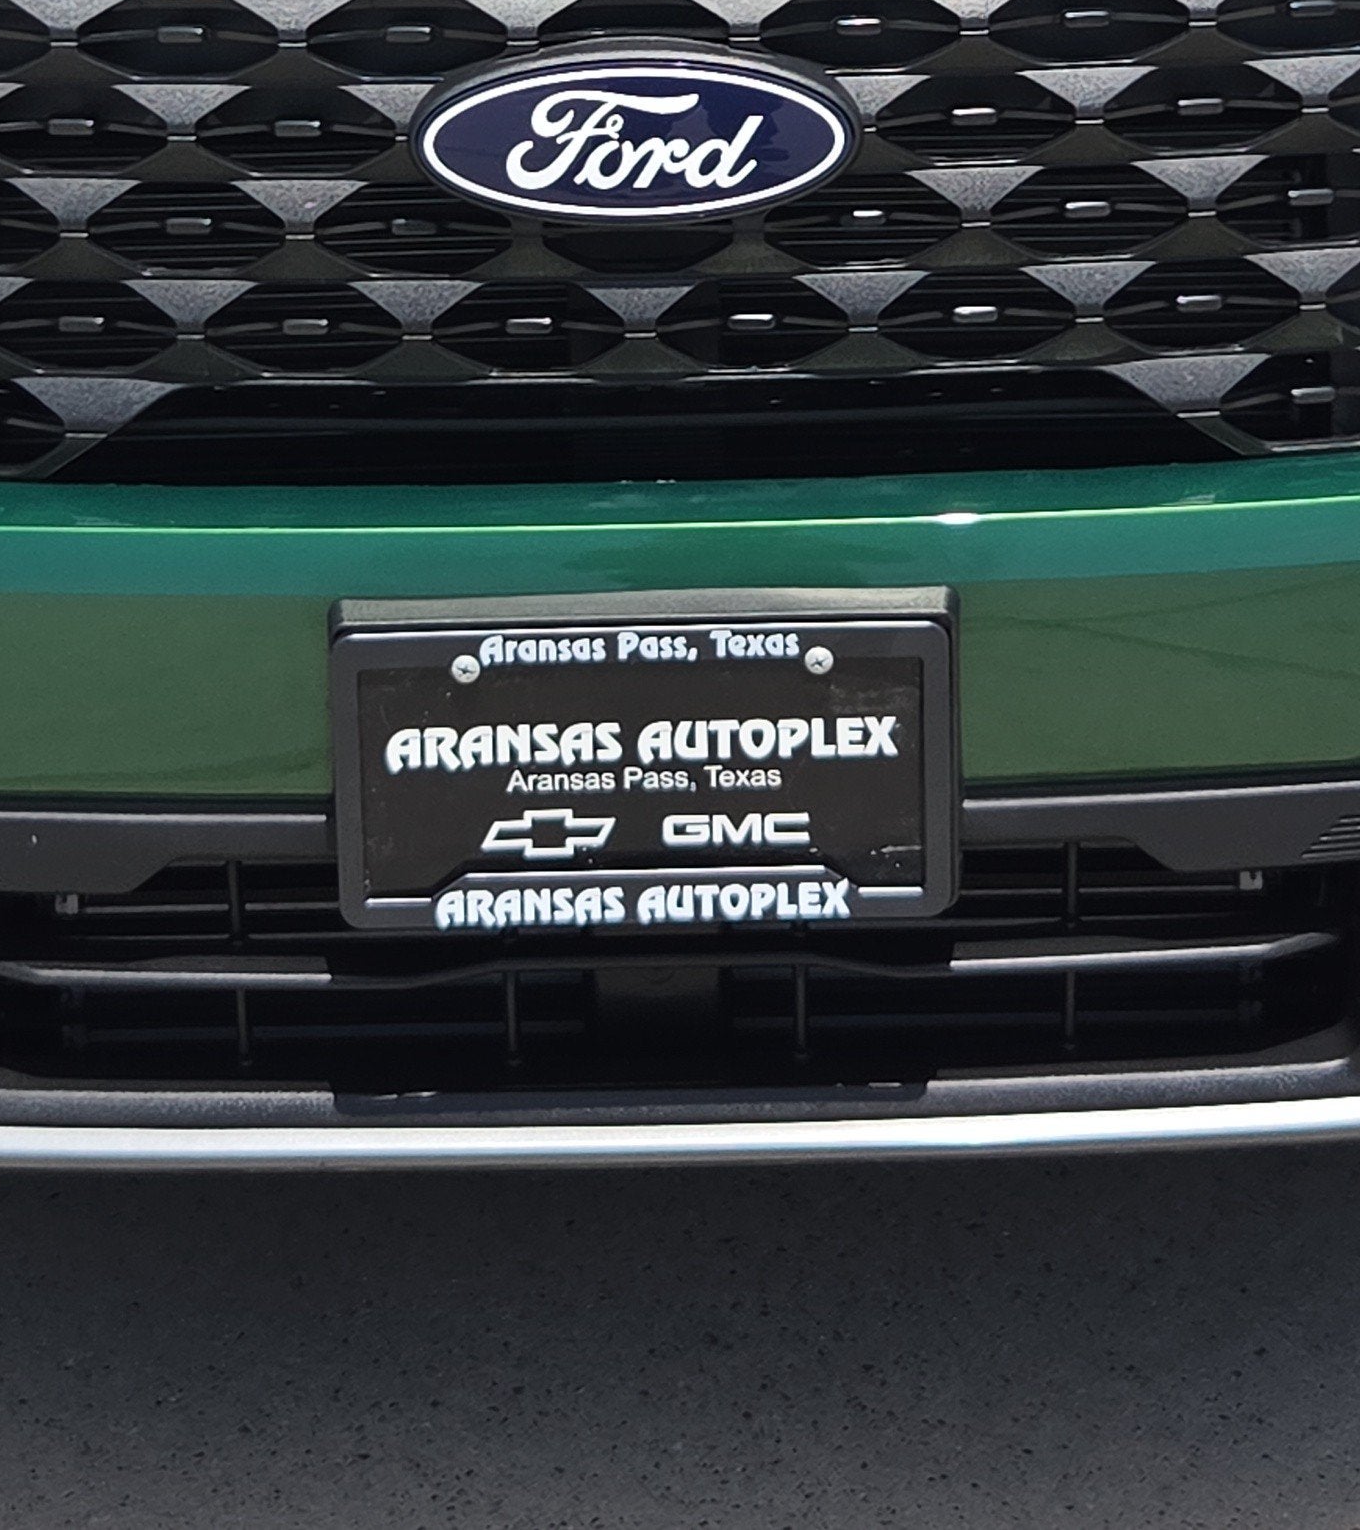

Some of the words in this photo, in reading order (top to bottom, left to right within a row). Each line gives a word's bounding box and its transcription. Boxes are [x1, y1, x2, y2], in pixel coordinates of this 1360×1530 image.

[505, 89, 765, 191] Ford
[478, 634, 607, 667] Aransas
[616, 630, 698, 661] Pass,
[709, 628, 801, 658] Texas
[384, 722, 624, 775] ARANSAS
[637, 715, 899, 766] AUTOPLEX
[506, 769, 616, 794] Aransas
[623, 766, 697, 793] Pass,
[703, 764, 783, 789] Texas
[662, 811, 811, 847] GMC
[435, 886, 626, 929] ARANSAS
[637, 877, 852, 925] AUTOPLEX
